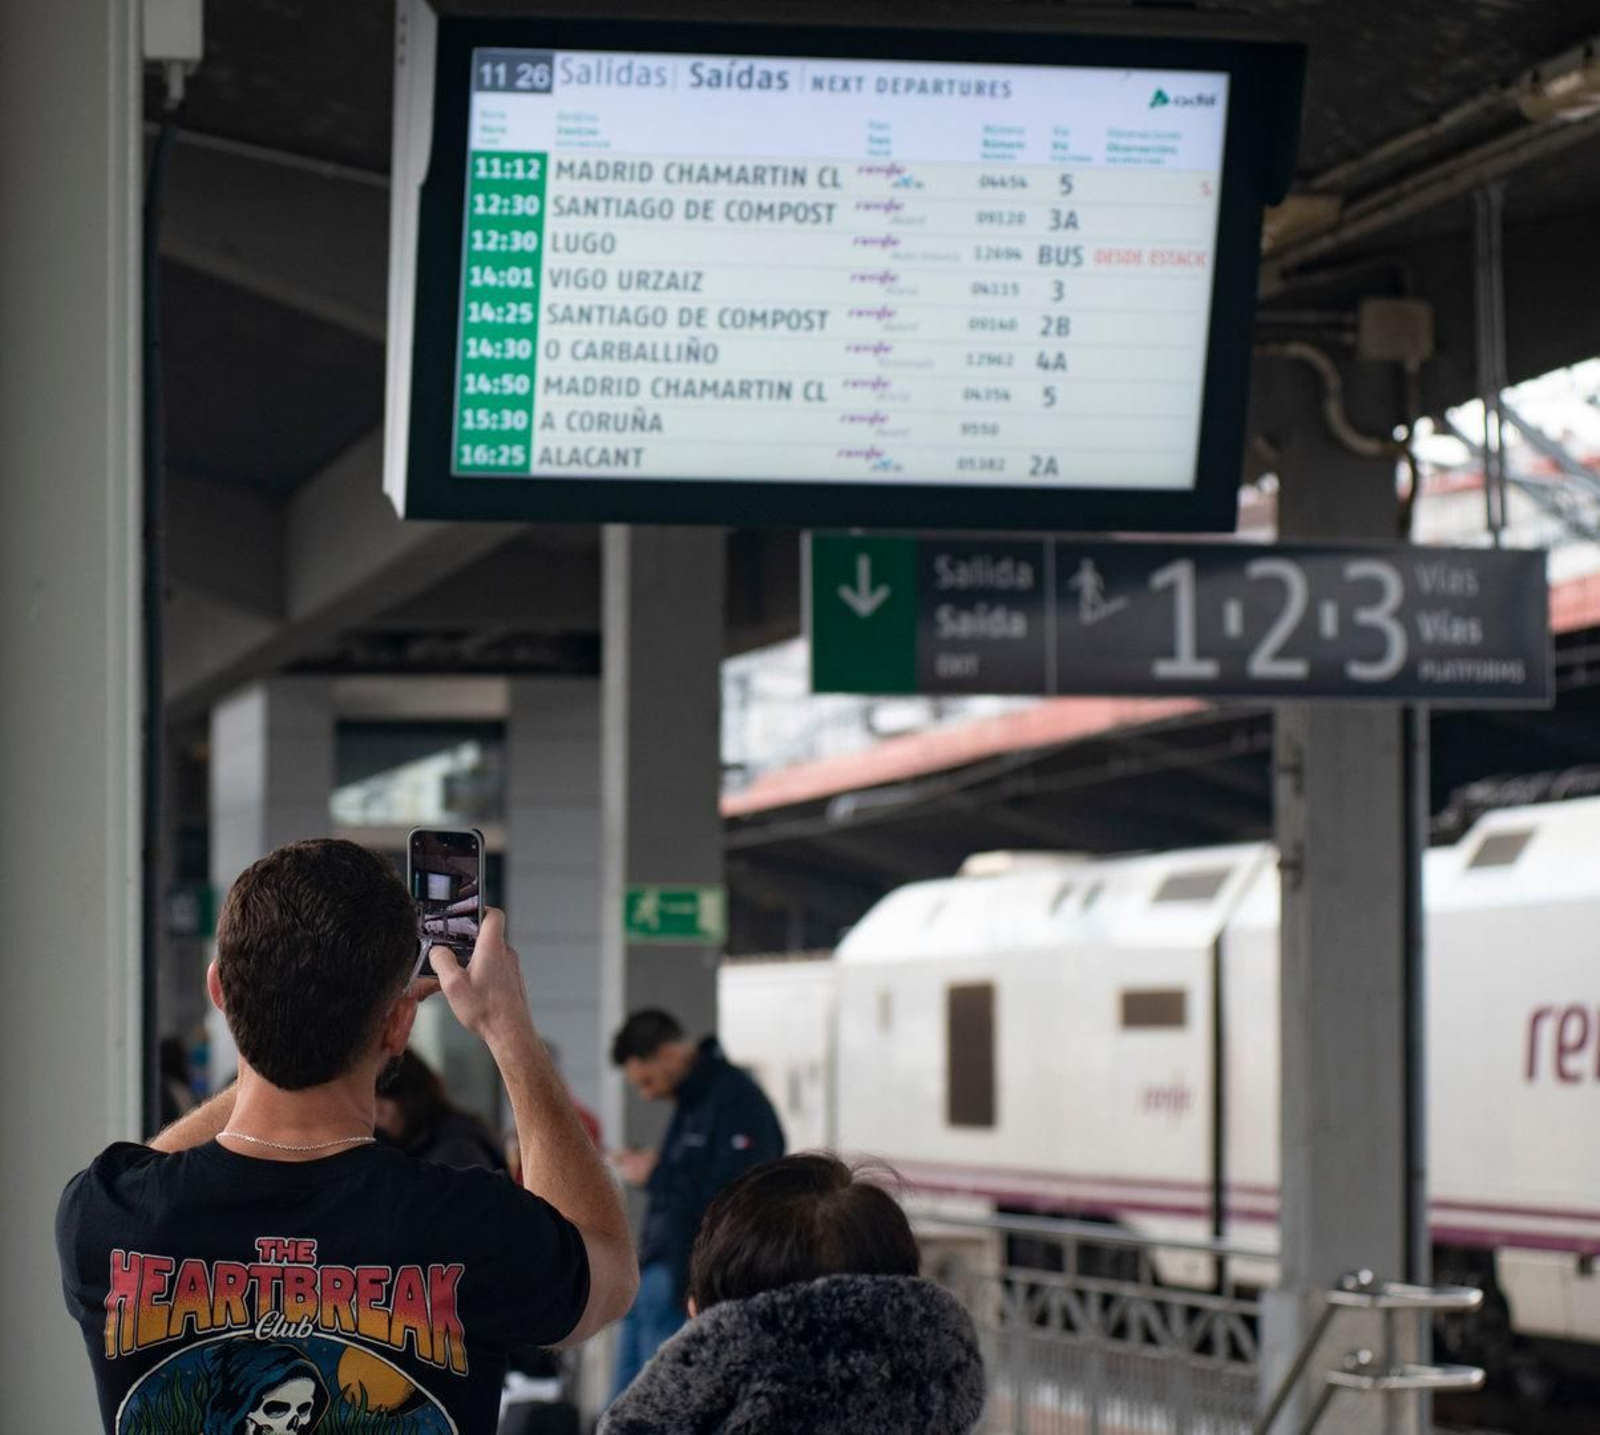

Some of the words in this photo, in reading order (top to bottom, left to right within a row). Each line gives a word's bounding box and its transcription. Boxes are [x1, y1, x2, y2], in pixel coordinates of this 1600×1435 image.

[479, 63, 507, 87] 11
[516, 63, 551, 88] 26
[560, 57, 668, 88] Salidas
[690, 59, 789, 91] Saídas
[811, 74, 865, 94] NEXT
[876, 76, 1012, 99] DEPARTURES
[474, 156, 540, 181] 11:12
[555, 160, 654, 184] MADRID
[663, 163, 808, 187] CHAMARTIN
[817, 167, 842, 189] CL
[1060, 173, 1075, 196] 5
[472, 193, 539, 218] 12:30
[552, 195, 674, 220] SANTIAGO
[684, 198, 714, 221] DE
[725, 201, 838, 225] COMPOST
[1049, 208, 1080, 232] 3A
[471, 229, 539, 253] 12:30
[551, 231, 617, 255] LUGO
[1038, 244, 1085, 267] BUS
[469, 265, 535, 288] 14:01
[548, 268, 608, 291] VIGO
[617, 271, 704, 293] URZAIZ
[1051, 279, 1066, 303] 3
[467, 302, 534, 325] 14:25
[547, 303, 668, 328] SANTIAGO
[677, 306, 707, 329] DE
[717, 307, 831, 331] COMPOST
[1039, 315, 1071, 338] 2B
[466, 337, 532, 360] 14:30
[544, 339, 560, 362] O
[570, 336, 720, 365] CARBALLIÑO
[1036, 350, 1068, 373] 4A
[464, 373, 530, 396] 14:50
[543, 375, 641, 399] MADRID
[649, 377, 793, 401] CHAMARTIN
[802, 381, 829, 403] CL
[1042, 385, 1058, 408] 5
[462, 409, 529, 431] 15:30
[540, 411, 556, 432] A
[566, 406, 664, 433] CORUÑA
[460, 445, 526, 467] 16:25
[538, 445, 645, 469] ALACANT
[1029, 454, 1060, 477] 2A
[933, 553, 1035, 591] Salida
[935, 600, 1028, 639] Saída
[1416, 608, 1483, 646] Vías
[1525, 1003, 1600, 1084] re
[256, 1236, 317, 1265] THE
[105, 1249, 469, 1376] HEARTBREAK
[254, 1311, 315, 1340] Club
